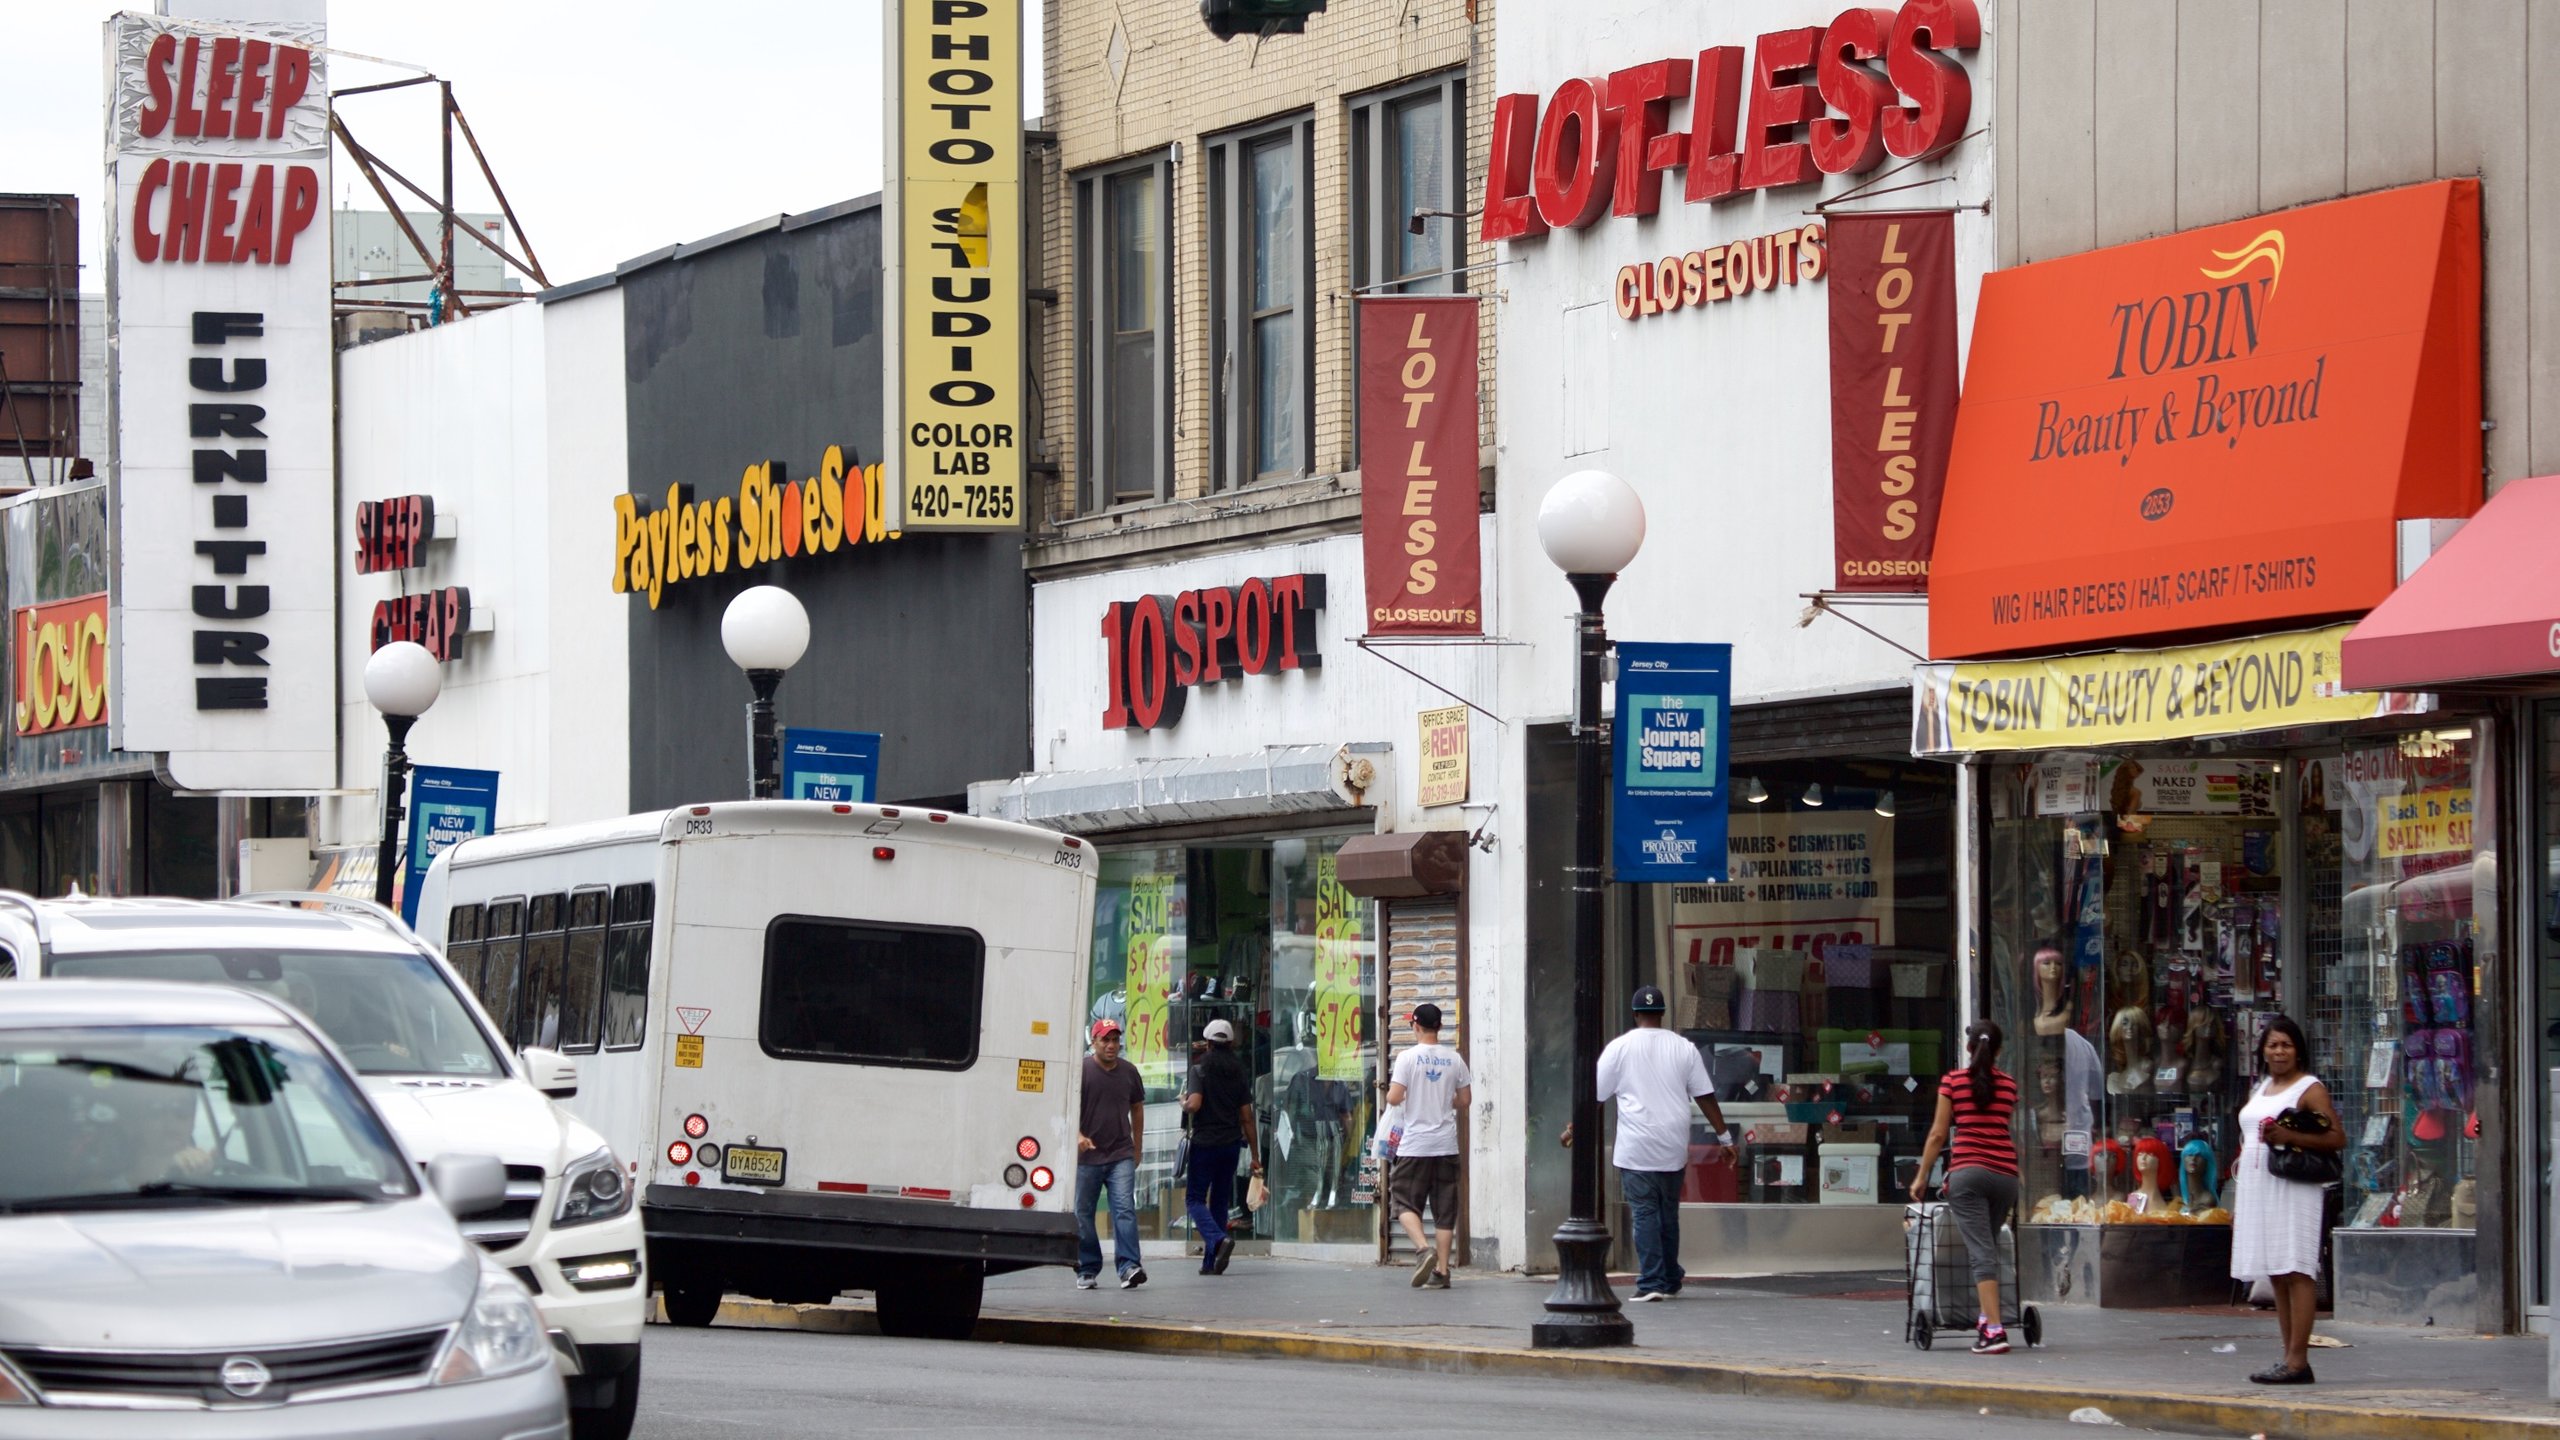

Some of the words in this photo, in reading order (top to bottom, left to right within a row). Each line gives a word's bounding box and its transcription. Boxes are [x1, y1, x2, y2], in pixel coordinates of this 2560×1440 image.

[139, 34, 310, 140] SLEEP
[928, 0, 994, 165] PHOTO
[1481, 0, 1981, 243] LOT-LESS
[132, 158, 319, 266] CHEAP
[1616, 223, 1827, 321] CLOSEOUTS
[1876, 224, 1914, 354] LOT
[2108, 277, 2273, 380] TOBIN
[1401, 313, 1437, 429] LOT
[2029, 396, 2148, 467] Beauty
[2154, 391, 2181, 444] &
[2188, 355, 2328, 450] Beyond
[911, 422, 1014, 449] COLOR
[933, 452, 991, 476] LAB
[1877, 367, 1918, 541] LESS
[188, 311, 271, 710] FURNITURE
[911, 484, 1014, 519] 420-7255
[2142, 492, 2172, 517] 2853
[612, 481, 733, 611] Payless
[738, 444, 902, 569] ShoeSou
[1402, 441, 1438, 595] LESS
[355, 494, 434, 576] SLEEP
[1992, 594, 2021, 626] WIG
[2033, 588, 2069, 621] HAIR
[2073, 580, 2127, 615] PIECES
[2176, 566, 2230, 604] SCARF
[2243, 556, 2316, 594] T-SHIRTS
[1373, 607, 1477, 625] CLOSEOUTS
[1101, 594, 1187, 731] 10
[1173, 573, 1326, 688] SPOT
[1631, 660, 1654, 669] Jersey
[1655, 660, 1669, 669] City
[16, 607, 110, 732] joyc
[1661, 695, 1684, 710] the
[1957, 675, 2046, 734] TOBIN
[2066, 667, 2164, 729] BEAUTY
[2166, 663, 2186, 721] &
[2193, 650, 2303, 717] BEYOND
[1423, 712, 1444, 728] OFFICE
[1446, 709, 1464, 725] SPACE
[1655, 712, 1690, 728] NEW
[815, 745, 827, 753] City
[1431, 724, 1466, 758] RENT
[1639, 727, 1706, 748] Journal
[1642, 747, 1702, 770] Square
[2344, 752, 2379, 783] Hello
[819, 773, 837, 786] the
[2153, 777, 2197, 788] NAKED
[813, 786, 841, 800] NEW
[1687, 790, 1713, 798] Community
[439, 817, 464, 829] NEW
[444, 805, 461, 816] the
[2388, 803, 2419, 821] Back
[2427, 800, 2441, 817] To
[686, 819, 713, 835] DR33
[2387, 823, 2437, 851] SALE!!
[1642, 841, 1697, 853] PROVIDENT
[1788, 834, 1867, 852] COSMETICS
[1054, 850, 1082, 869] DR33
[1656, 853, 1684, 863] BANK
[1740, 858, 1824, 878] APPLIANCES
[1836, 856, 1872, 876] TOYS
[1674, 885, 1746, 904] FURNITURE
[1757, 882, 1833, 902] HARDWARE
[1845, 880, 1878, 899] FOOD
[1129, 941, 1148, 994] $3
[1645, 993, 1654, 1006] S
[1130, 1013, 1151, 1064] $7
[1319, 1003, 1339, 1057] $7
[1344, 1006, 1361, 1060] $9
[1416, 1054, 1452, 1067] Adidas
